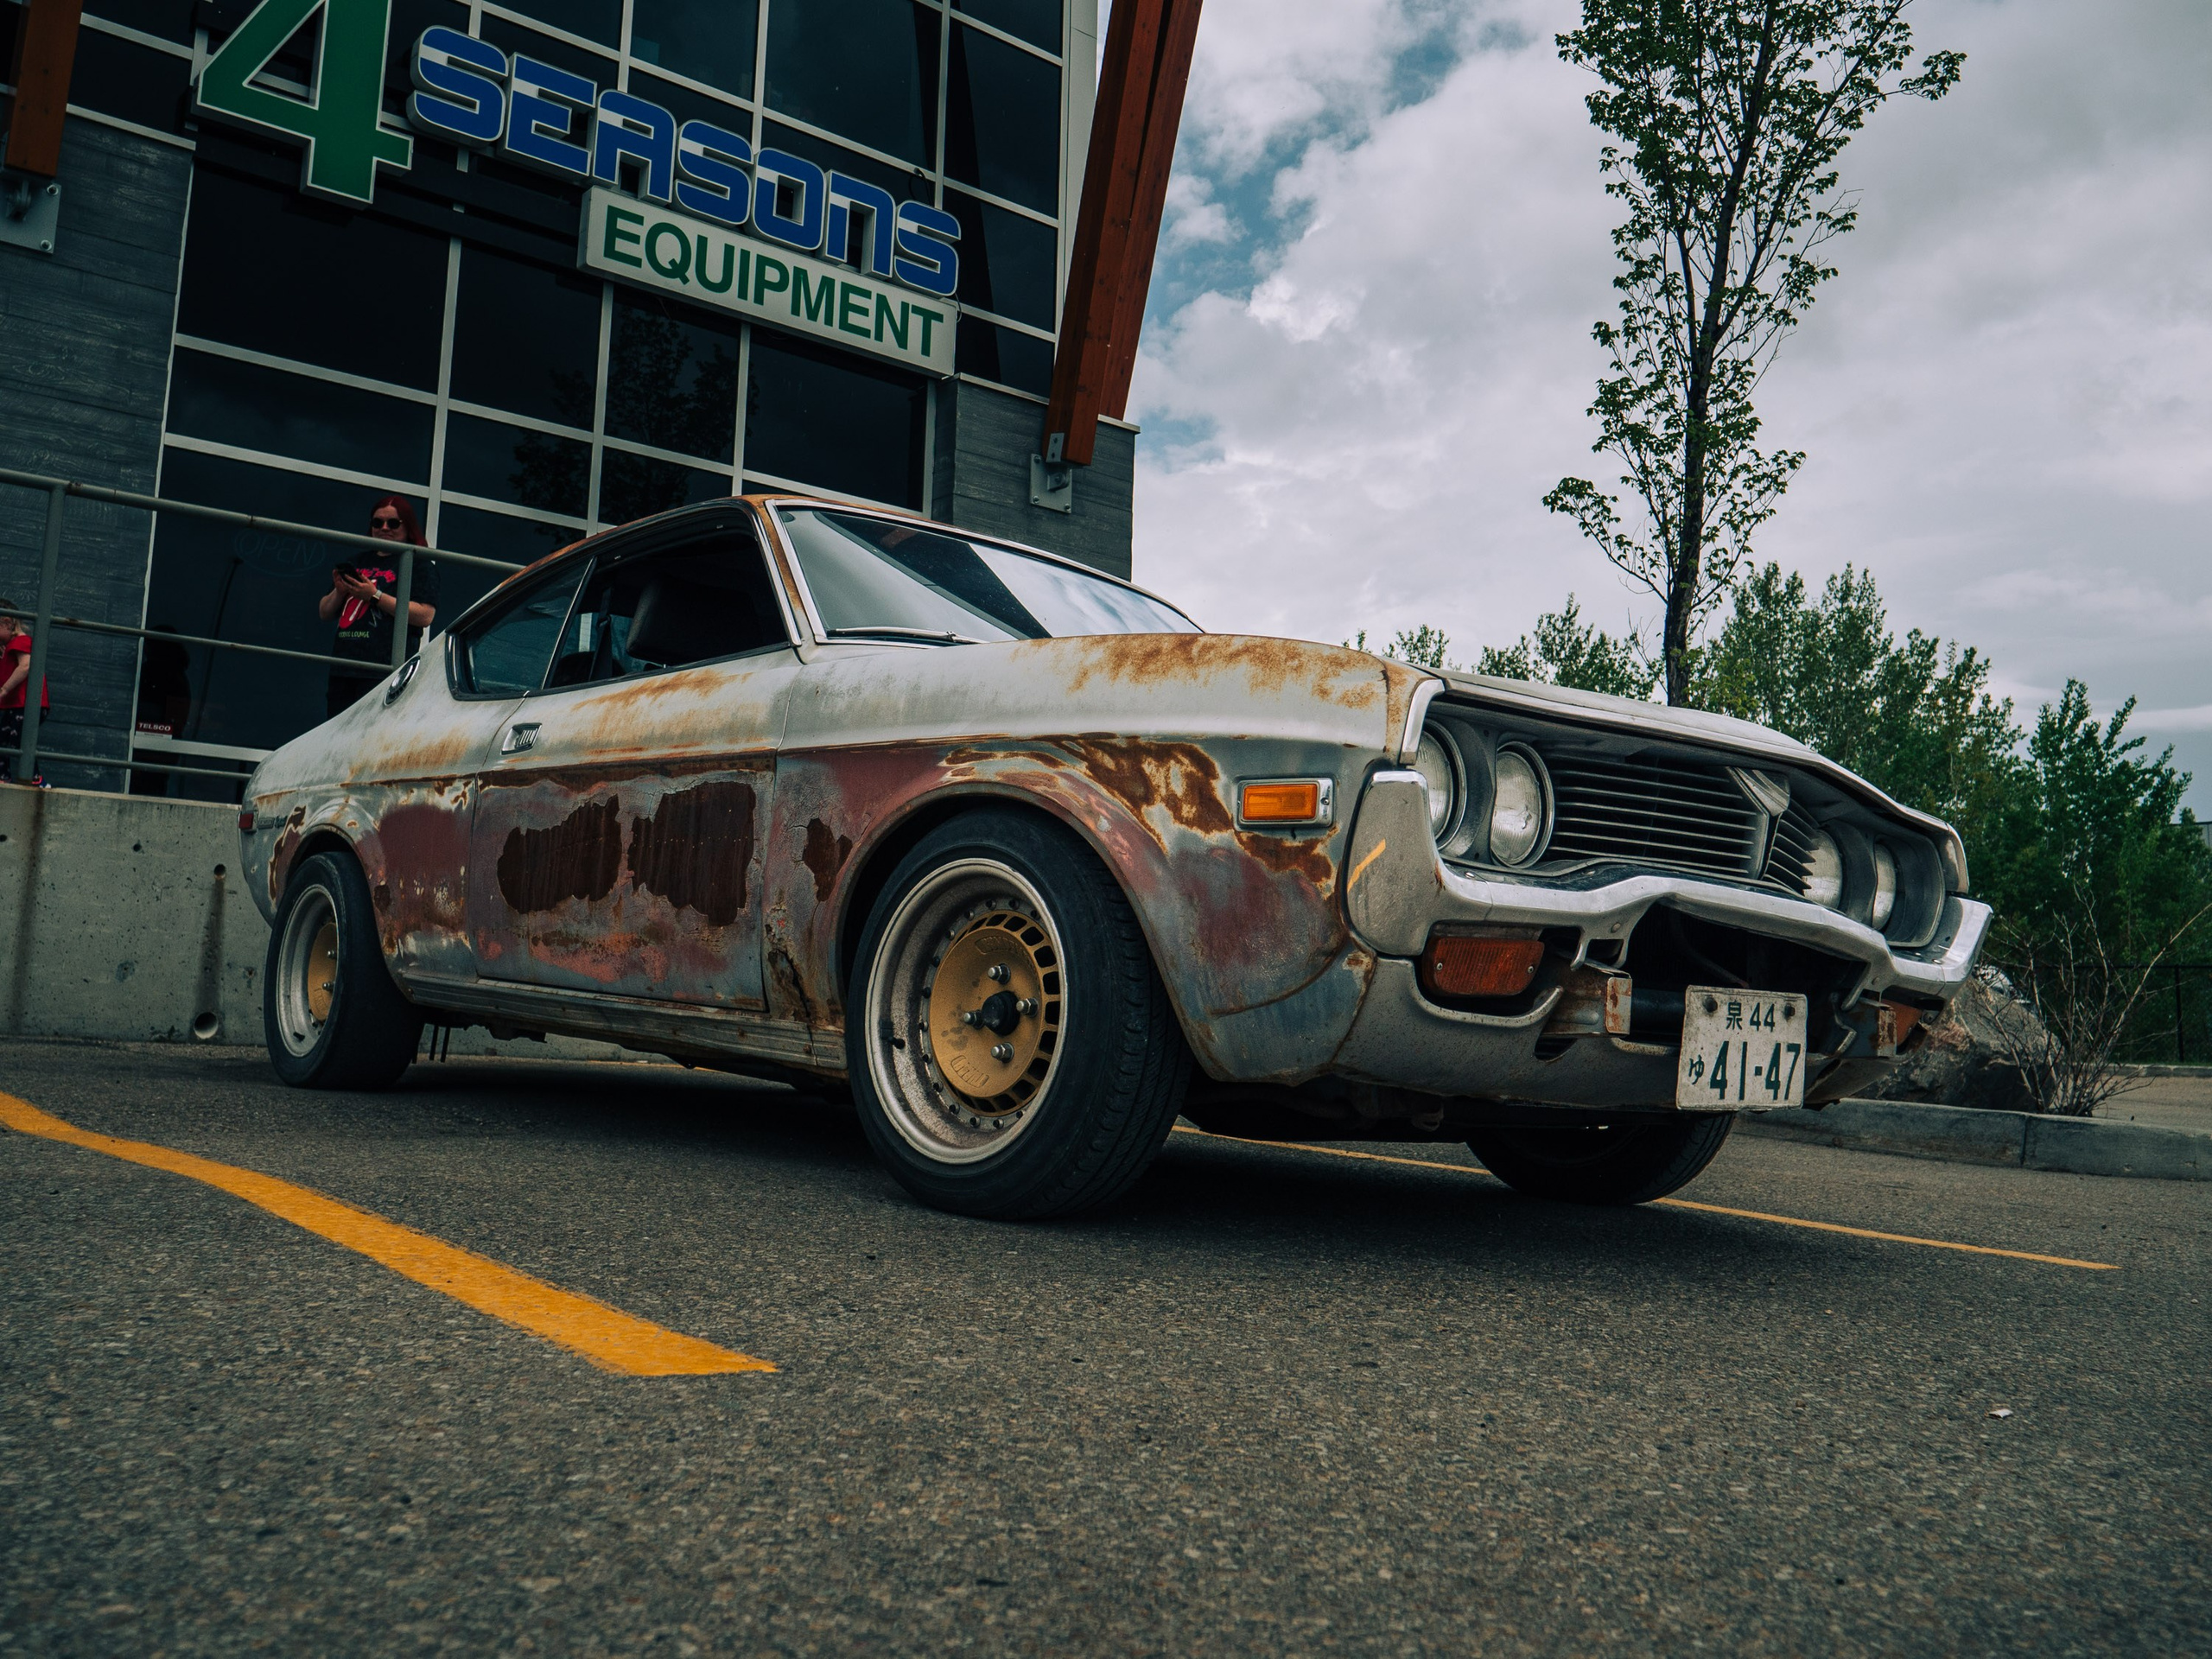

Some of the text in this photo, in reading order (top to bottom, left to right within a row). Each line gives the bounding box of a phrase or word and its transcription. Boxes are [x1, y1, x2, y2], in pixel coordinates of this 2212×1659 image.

[195, 0, 962, 297] 4 SEASONS
[603, 207, 944, 357] EQUIPMENT
[238, 530, 320, 567] OPEN
[1726, 1000, 1776, 1033] 泉 44
[1688, 1054, 1705, 1085] ゆ
